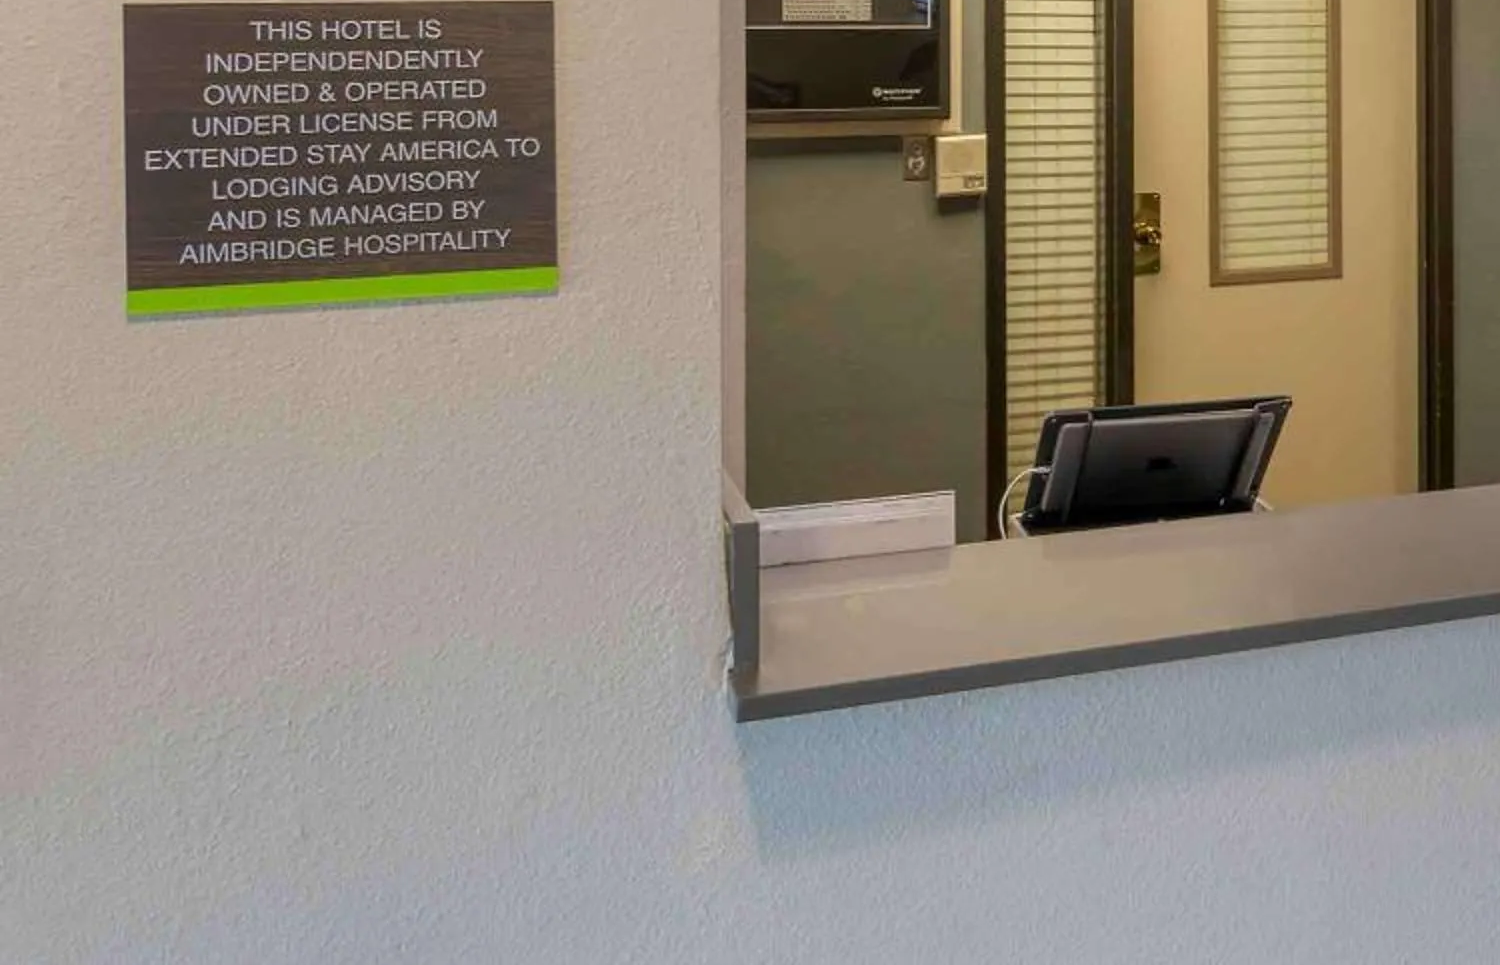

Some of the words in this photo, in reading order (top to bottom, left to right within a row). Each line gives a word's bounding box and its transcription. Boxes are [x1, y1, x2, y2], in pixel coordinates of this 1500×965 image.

[250, 20, 313, 41] THIS
[321, 20, 410, 39] HOTEL
[418, 19, 442, 38] IS
[203, 83, 309, 105] OWNED
[318, 83, 336, 102] &
[345, 79, 486, 101] OPERATED
[192, 114, 290, 137] UNDER
[299, 111, 413, 134] LICENSE
[422, 109, 497, 130] FROM
[144, 146, 297, 170] EXTENDED
[307, 143, 371, 164] STAY
[380, 140, 498, 162] AMERICA
[505, 138, 540, 158] TO
[212, 175, 338, 200] LODGING
[347, 170, 481, 194] ADVISORY
[208, 210, 266, 232] AND
[276, 208, 301, 227] IS
[310, 203, 443, 227] MANAGED
[452, 200, 485, 220] BY
[179, 237, 335, 264] AIMBRIDGE
[344, 229, 511, 257] HOSPITALITY
